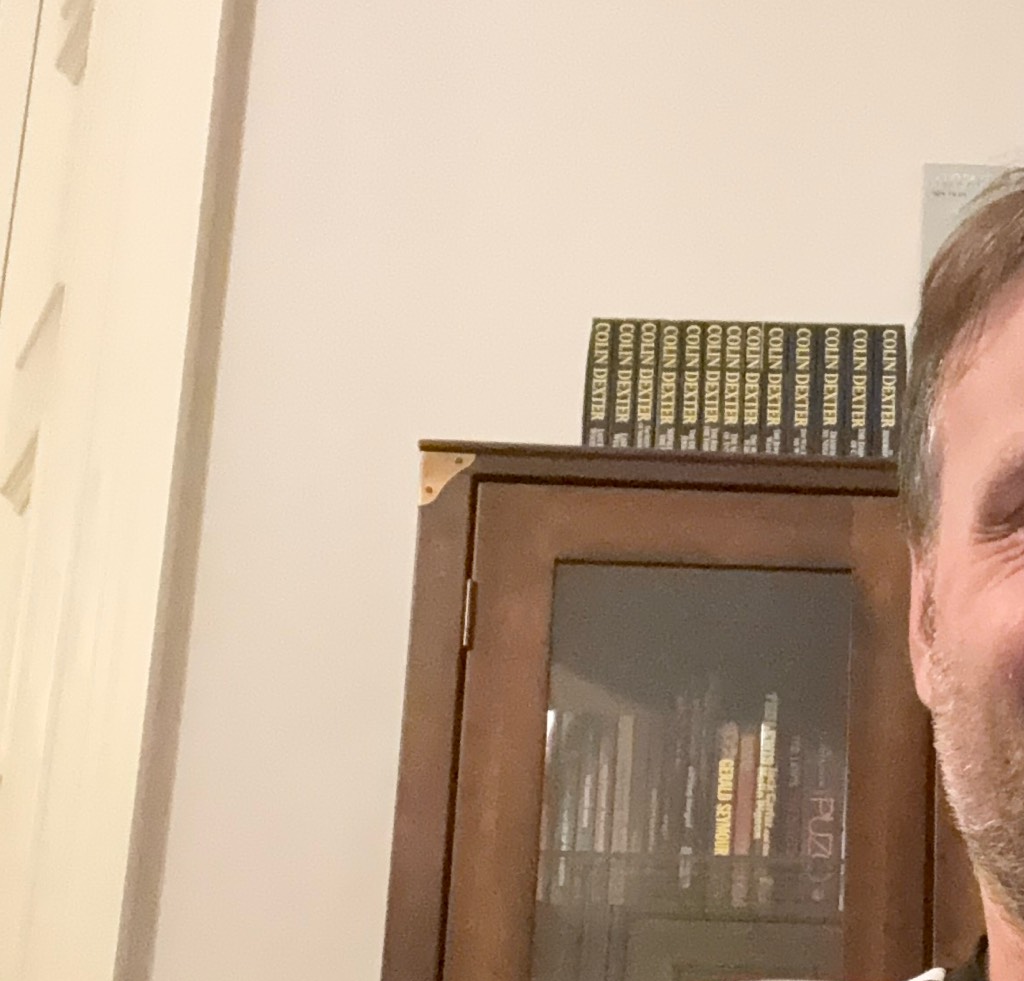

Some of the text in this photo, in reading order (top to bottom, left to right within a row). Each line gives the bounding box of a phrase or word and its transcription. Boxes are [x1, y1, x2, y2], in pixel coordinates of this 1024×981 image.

[594, 322, 611, 364] COLIN
[619, 324, 634, 365] COLIN
[640, 322, 656, 365] COLIN
[663, 326, 678, 367] COLIN
[686, 325, 700, 367] COLIN
[707, 325, 722, 366] COLIN
[726, 326, 741, 368] COLIN
[746, 326, 761, 368] COLIN
[769, 328, 783, 369] COLIN
[796, 328, 811, 370] COLIN
[825, 328, 839, 369] COLIN
[853, 329, 867, 370] COLIN
[883, 330, 897, 371] COLIN
[591, 368, 608, 420] DEXTER
[616, 370, 632, 422] DEXTER
[637, 368, 654, 421] DEXTER
[660, 372, 676, 424] DEXTER
[683, 371, 699, 424] DEXTER
[705, 371, 720, 423] DEXTER
[724, 372, 740, 425] DEXTER
[744, 373, 760, 425] DEXTER
[767, 373, 782, 426] DEXTER
[794, 374, 809, 427] DEXTER
[823, 374, 838, 425] DEXTER
[852, 375, 867, 427] DEXTER
[881, 375, 896, 427] DEXTER
[717, 759, 735, 801] GERALD
[713, 803, 732, 856] SEYMOUR
